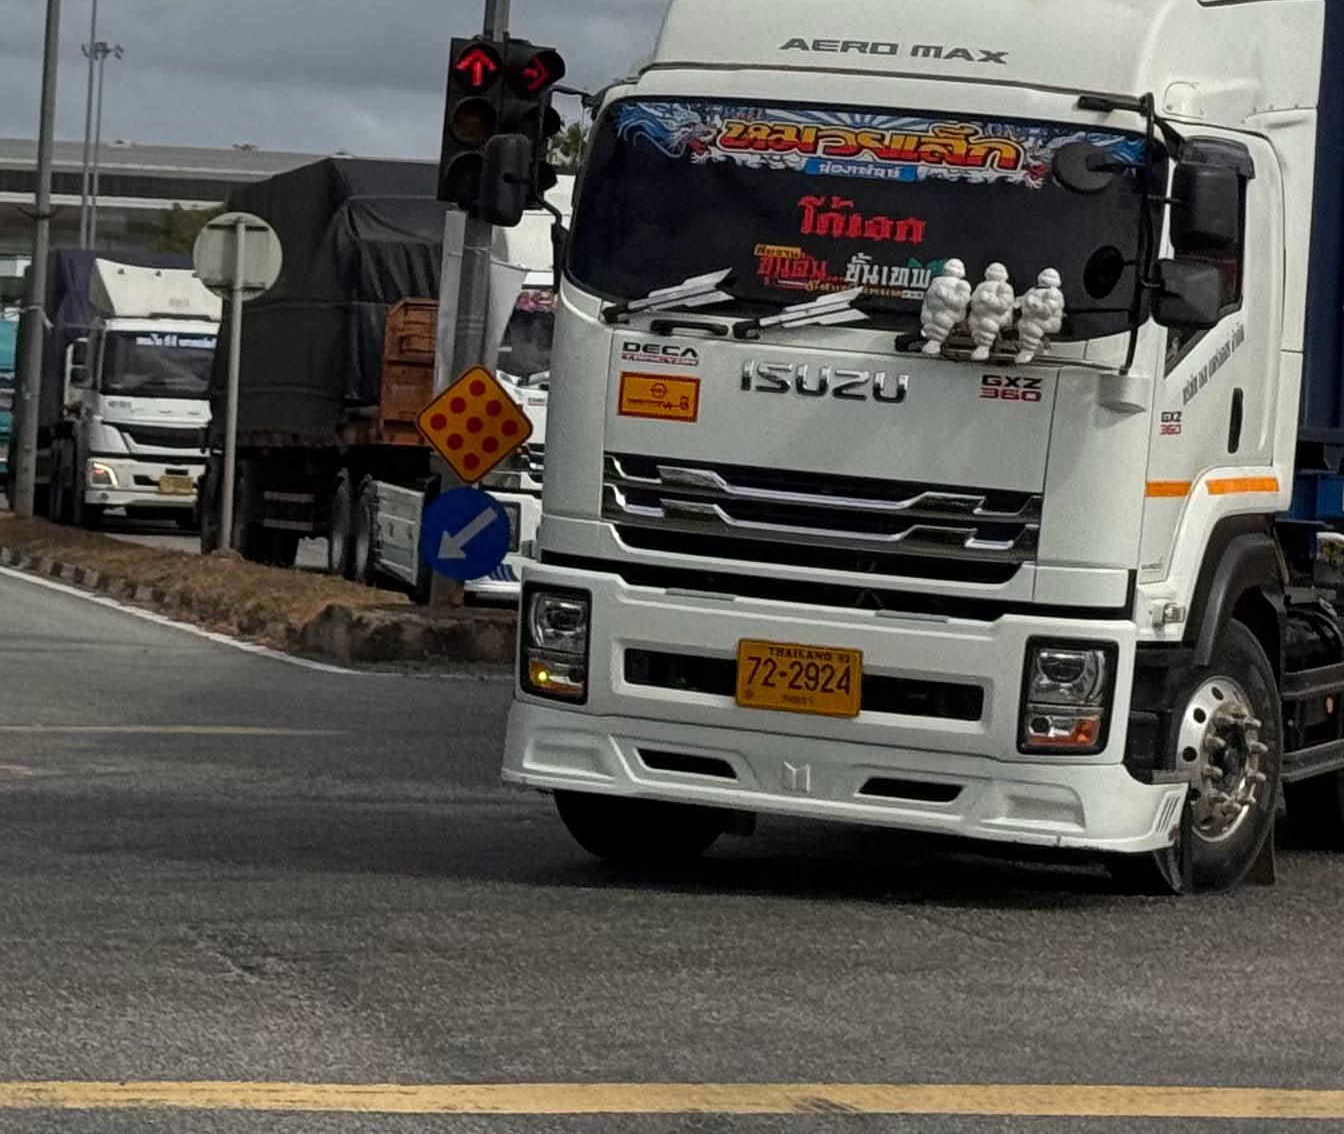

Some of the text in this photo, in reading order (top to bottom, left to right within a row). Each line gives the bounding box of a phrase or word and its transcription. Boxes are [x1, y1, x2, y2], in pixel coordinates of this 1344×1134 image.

[779, 38, 1010, 65] AERO MAX
[621, 341, 698, 358] DECA
[740, 360, 911, 404] ISUZU
[981, 374, 1043, 389] GXZ
[979, 387, 1043, 403] 360
[768, 646, 832, 662] THAILAND
[746, 656, 853, 696] 72-2924
